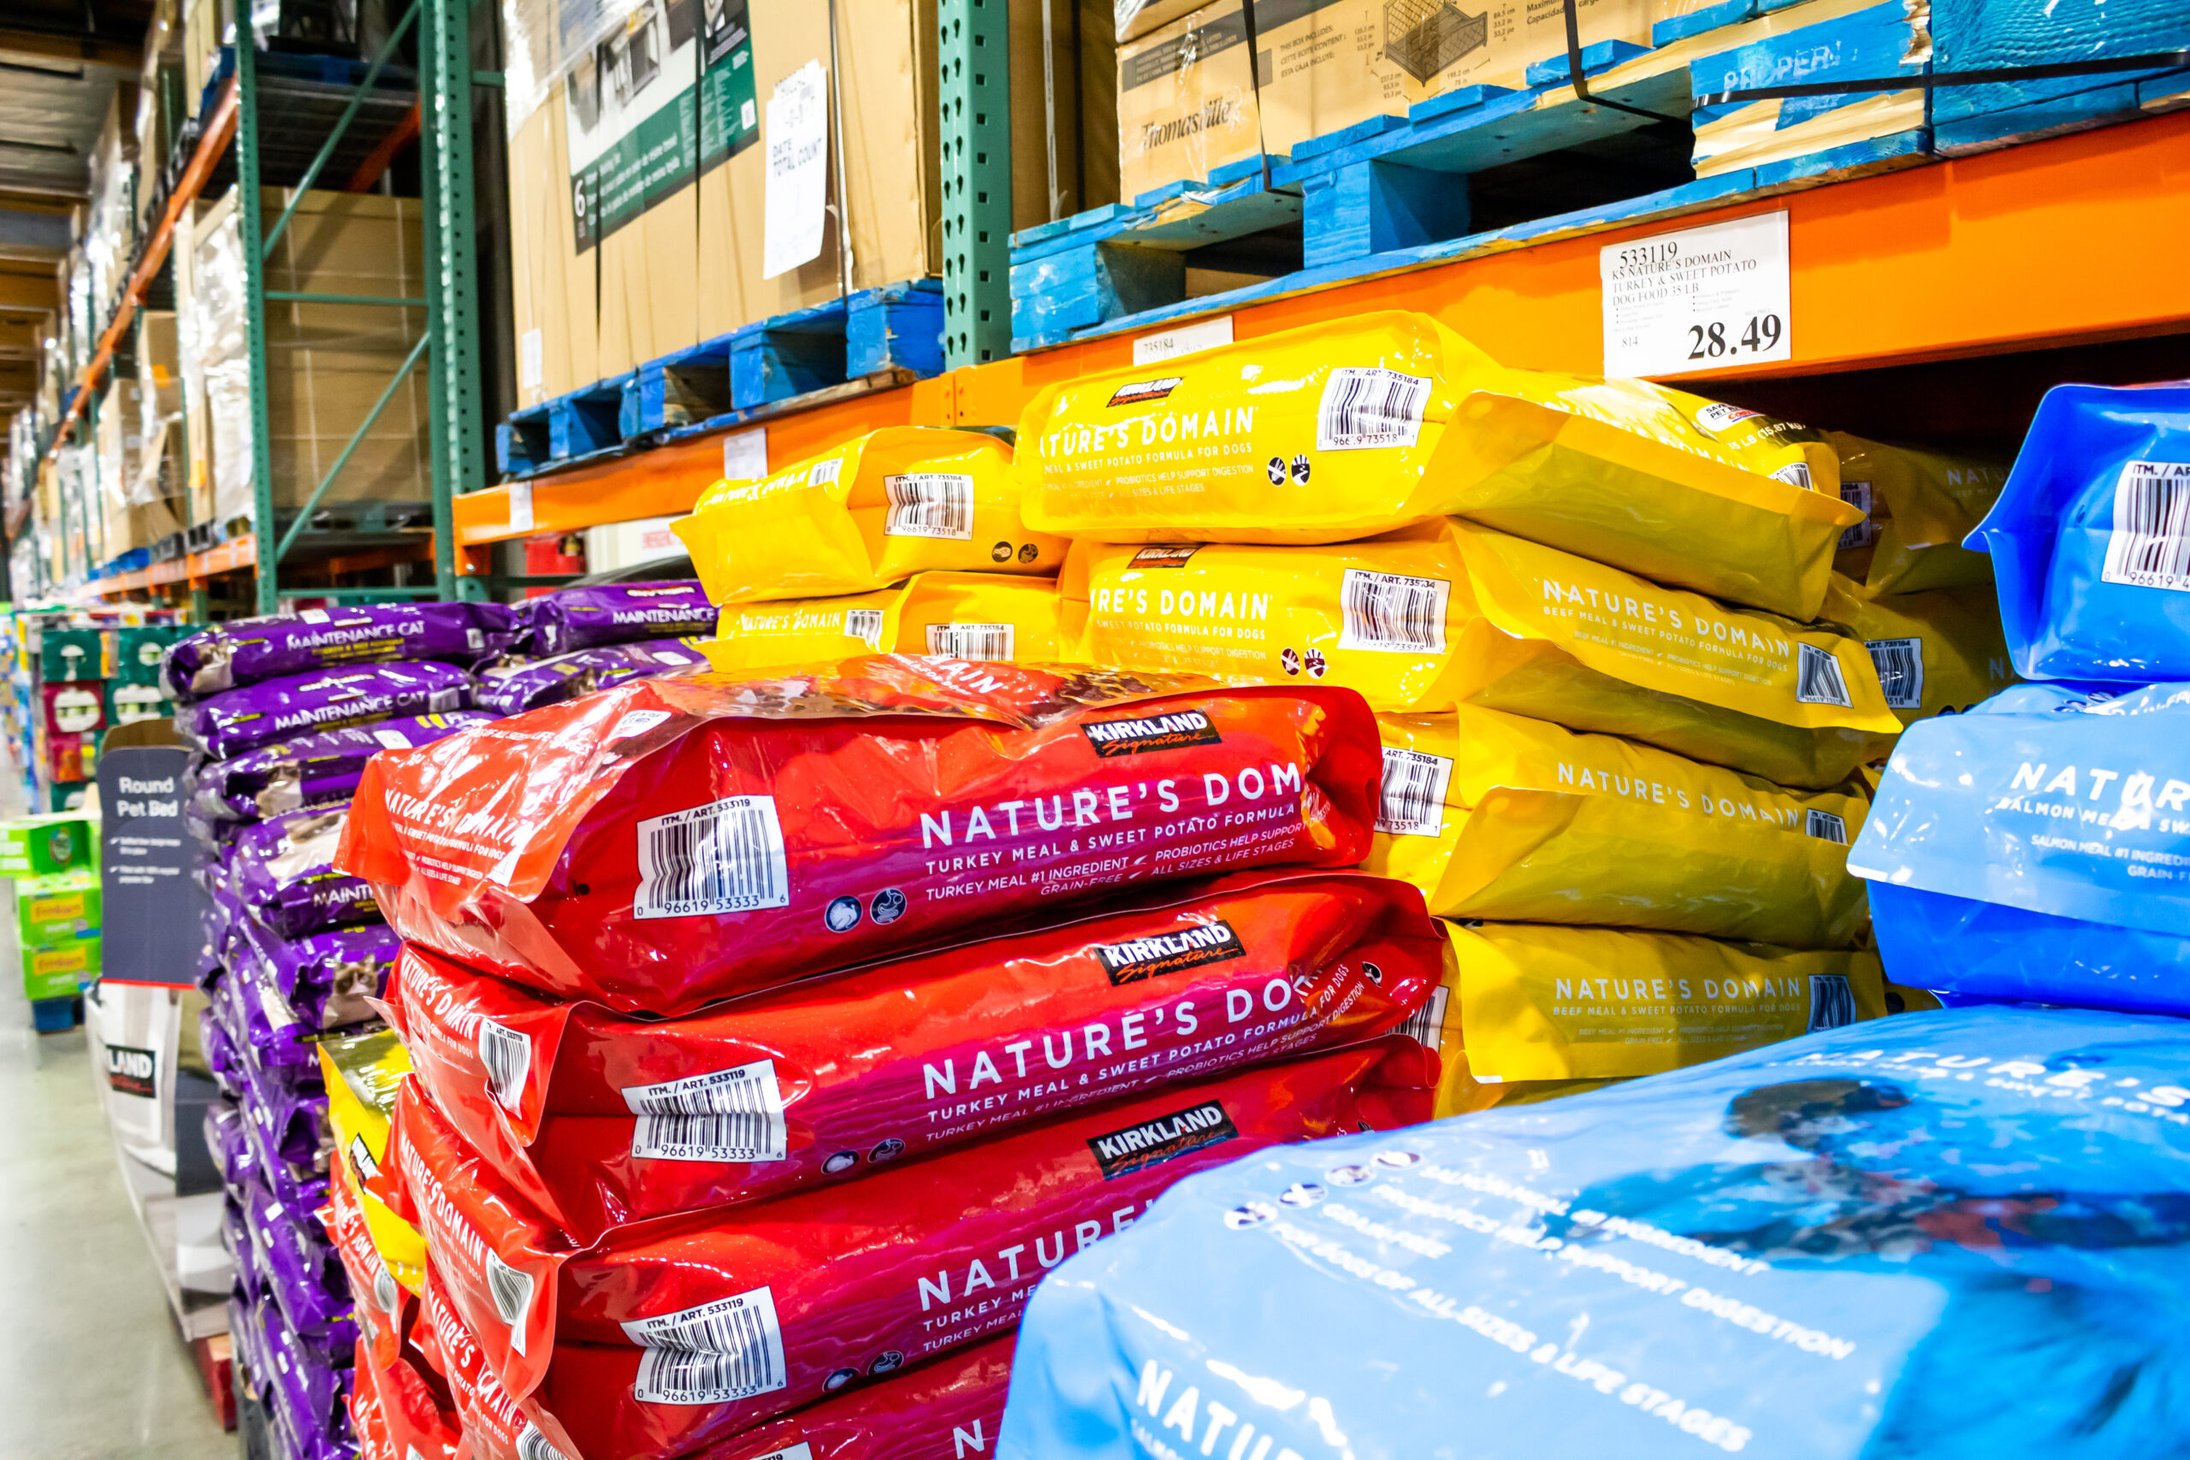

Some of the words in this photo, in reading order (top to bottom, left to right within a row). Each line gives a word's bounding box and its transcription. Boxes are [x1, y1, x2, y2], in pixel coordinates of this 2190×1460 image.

[1526, 7, 1565, 25] Capacidad
[575, 179, 586, 217] 6
[1612, 269, 1625, 281] KS
[1628, 258, 1682, 278] NATURE'S
[1685, 249, 1732, 268] DOMAIN
[1619, 241, 1678, 269] 533119
[1614, 276, 1653, 293] TURKEY
[1670, 267, 1706, 282] SWEET
[1710, 259, 1757, 277] POTATO
[1613, 295, 1635, 307] DOG
[1639, 287, 1668, 303] FOOD
[1685, 282, 1699, 295] LB
[1622, 336, 1639, 348] 814
[1687, 313, 1781, 360] 28.49
[1386, 371, 1419, 386] 735184
[1142, 406, 1255, 446] DOMAIN
[1741, 434, 1757, 447] LB
[1075, 460, 1104, 472] SWEET
[1107, 454, 1143, 468] POTATO
[1146, 448, 1194, 464] FORMULA
[1197, 446, 1219, 458] FOR
[1223, 441, 1253, 455] DOGS
[2133, 464, 2158, 475] ITM.
[1115, 472, 1157, 486] PROBIOTICS
[1158, 471, 1176, 482] HELP
[1177, 467, 1210, 481] SUPPORT
[1212, 464, 1255, 477] DIGESTION
[1159, 485, 1176, 496] LIFE
[1177, 483, 1205, 494] STAGES
[932, 527, 957, 536] 73518
[1381, 574, 1402, 585] ART.
[2129, 571, 2174, 588] 96619
[613, 608, 715, 624] MAINTENANCE
[1160, 589, 1269, 621] DOMAIN
[1543, 579, 1683, 629] NATURE'S
[1696, 616, 1790, 658] DOMAIN
[286, 624, 395, 651] MAINTENANCE
[398, 621, 425, 636] CAT
[1164, 623, 1209, 636] FORMULA
[1212, 626, 1233, 637] FOR
[1236, 628, 1266, 640] DOGS
[1543, 605, 1573, 618] BEEF
[1578, 611, 1608, 626] MEAL
[1621, 620, 1656, 637] SWEET
[1659, 629, 1696, 647] POTATO
[1699, 641, 1744, 659] FORMULA
[1746, 651, 1765, 664] FOR
[1766, 658, 1789, 673] DOGS
[1226, 647, 1267, 660] DIGESTION
[275, 696, 393, 730] MAINTENANCE
[397, 691, 426, 706] CAT
[1088, 712, 1209, 742] KIRKLAND
[1103, 731, 1204, 756] Signature
[1385, 749, 1404, 759] ART.
[118, 776, 175, 794] Round
[1558, 762, 1691, 809] NATURE'S
[1702, 793, 1800, 828] DOMAIN
[117, 801, 148, 818] Pet
[149, 800, 179, 818] Bed
[385, 788, 455, 828] NATURE'S
[661, 813, 684, 827] ITM.
[692, 805, 717, 820] ART.
[717, 797, 751, 813] 533119
[920, 779, 1181, 850] NATURE'S
[926, 850, 1003, 875] TURKEY
[1012, 842, 1062, 863] MEAL
[1070, 838, 1080, 854] &
[1087, 828, 1147, 848] SWEET
[1154, 817, 1218, 839] POTATO
[1224, 803, 1296, 828] FORMULA
[1388, 820, 1419, 831] 73518
[926, 880, 985, 902] TURKEY
[987, 871, 1028, 892] MEAL
[1030, 870, 1046, 885] #1
[1047, 856, 1130, 881] INGREDIENT
[1154, 839, 1229, 862] PROBIOTICS
[1229, 832, 1260, 849] HELP
[1260, 820, 1306, 842] SUPPORT
[2031, 834, 2077, 851] SALMON
[2078, 841, 2113, 857] MEAL
[2114, 847, 2130, 859] #1
[1040, 873, 1122, 896] GRAIN-FREE
[1150, 861, 1175, 877] ALL
[1177, 856, 1211, 872] SIZES
[1213, 853, 1222, 867] &
[1224, 847, 1251, 865] LIFE
[1252, 837, 1295, 859] STAGES
[637, 907, 644, 917] 0
[664, 899, 710, 915] 96619
[715, 894, 761, 911] 53333
[779, 893, 786, 904] 6
[1104, 922, 1232, 968] KIRKLAND
[1115, 945, 1240, 983] Signature
[1555, 977, 1692, 1001] NATURE'S
[1704, 977, 1801, 999] DOMAIN
[1553, 1006, 1582, 1016] BEEF
[1587, 1006, 1616, 1016] MEAL
[1631, 1005, 1665, 1016] SWEET
[1670, 1004, 1708, 1015] POTATO
[1711, 1004, 1756, 1014] FORMULA
[1759, 1003, 1776, 1013] FOR
[922, 1001, 1199, 1100] NATURE'S
[928, 1099, 1008, 1123] TURKEY
[1017, 1081, 1070, 1106] MEAL
[1078, 1073, 1089, 1087] &
[1098, 1055, 1161, 1080] SWEET
[1168, 1033, 1237, 1062] POTATO
[1243, 1006, 1318, 1040] FORMULA
[1319, 985, 1337, 1008] FOR
[1332, 963, 1350, 988] DOGS
[926, 1119, 988, 1143] TURKEY
[989, 1109, 1029, 1129] MEAL
[1165, 1052, 1245, 1079] PROBIOTICS
[1247, 1038, 1278, 1056] HELP
[1279, 1016, 1331, 1044] SUPPORT
[1332, 981, 1366, 1020] DIGESTION
[648, 1086, 672, 1097] ITM.
[681, 1077, 708, 1091] ART.
[708, 1068, 746, 1085] 533119
[1097, 1107, 1223, 1159] KIRKLAND
[634, 1144, 641, 1154] 0
[660, 1143, 704, 1158] 96619
[711, 1143, 755, 1159] 53333
[776, 1149, 783, 1159] 6
[437, 1194, 485, 1267] DOMAIN
[428, 1288, 476, 1369] NATURE'S
[646, 1317, 671, 1330] ITM.
[678, 1309, 706, 1323] ART.
[706, 1297, 744, 1316] 533119
[923, 1298, 1001, 1332] TURKEY
[923, 1324, 983, 1352] TURKEY
[637, 1388, 645, 1399] 0
[663, 1387, 706, 1403] 96619
[713, 1384, 758, 1399] 53333
[776, 1378, 784, 1389] 6
[1620, 1382, 1752, 1453] STAGES
